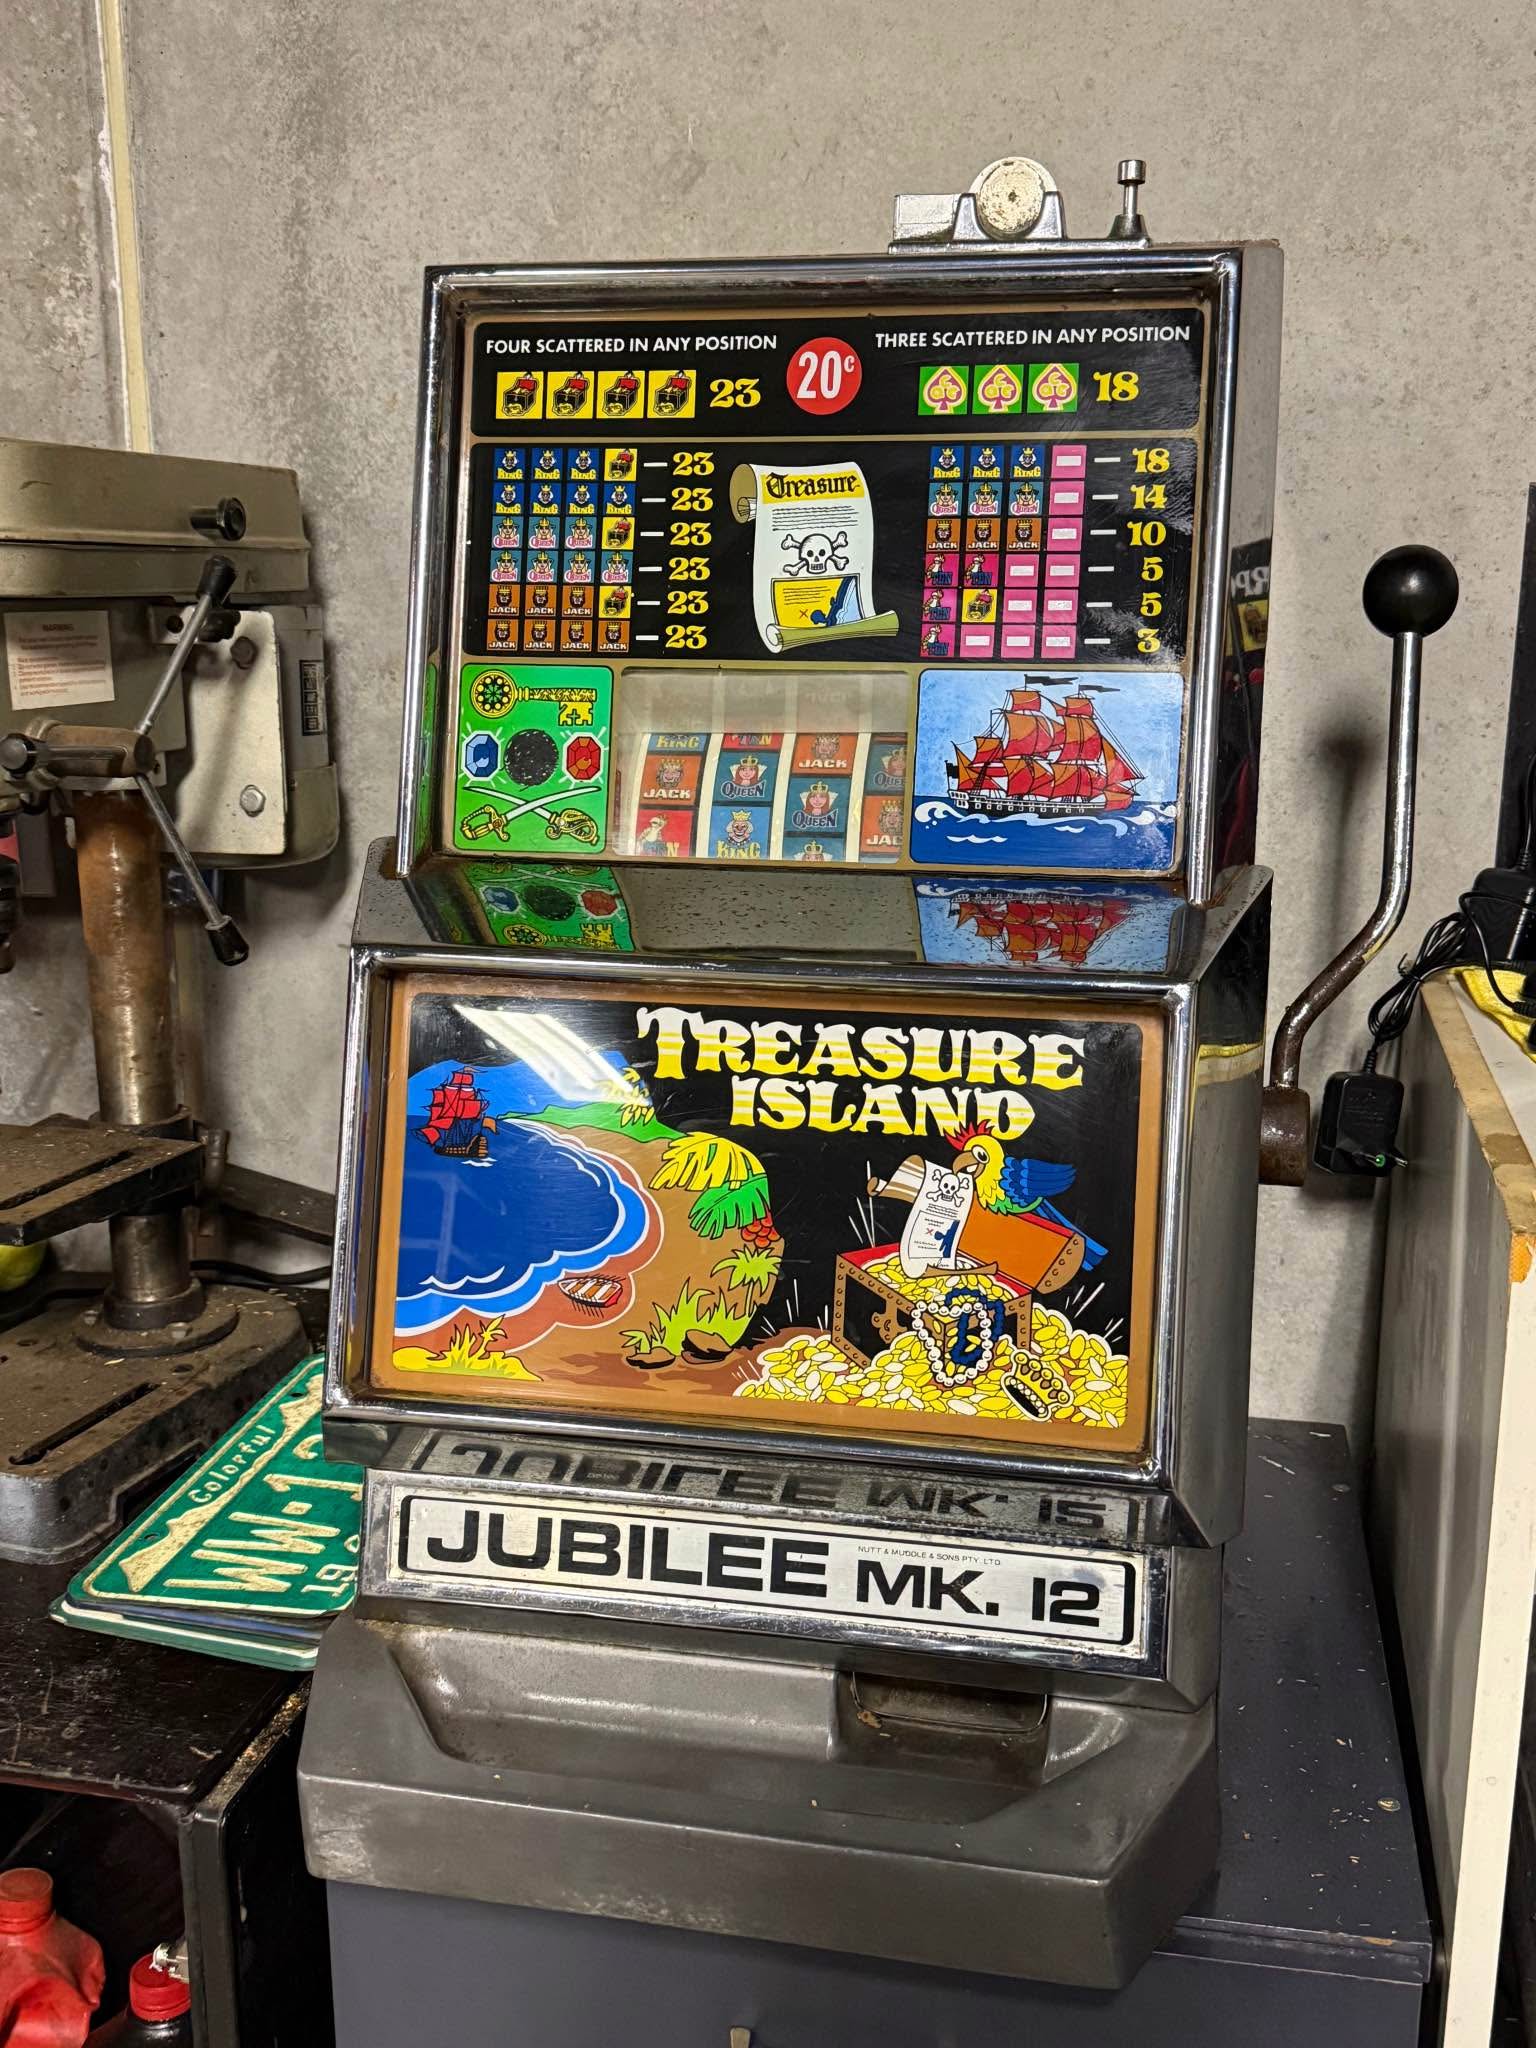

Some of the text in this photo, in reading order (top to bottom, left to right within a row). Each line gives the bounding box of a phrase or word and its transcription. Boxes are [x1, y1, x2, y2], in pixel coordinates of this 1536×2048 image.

[486, 334, 777, 354] FOUR SCATTERED IN ANY POSITION
[875, 325, 1191, 349] THREE SCATTERED IN ANY POSITION
[709, 378, 761, 408] 23
[1093, 371, 1139, 402] 18
[672, 452, 715, 475] 23
[1132, 448, 1170, 473] 18
[765, 472, 860, 498] Treasure
[1130, 484, 1168, 509] 14
[671, 487, 714, 511] 23
[670, 522, 712, 546] 23
[928, 521, 1167, 549] JACK JACK JACK 10
[668, 557, 710, 580] 23
[1141, 556, 1163, 581] 5
[490, 591, 709, 615] JACK JACK JACK 23
[1140, 592, 1162, 616] 5
[489, 625, 707, 650] JACK JACK JACK JACK 23
[1137, 628, 1161, 653] 3
[799, 759, 847, 768] JACK
[643, 780, 766, 799] JACK QUEEN
[792, 808, 839, 829] QUEEN
[717, 840, 760, 858] KING
[866, 834, 903, 845] JAC
[636, 1006, 1085, 1091] TREASURE
[730, 1076, 1036, 1141] ISLAND
[188, 1425, 276, 1503] Colorful
[427, 1510, 1100, 1627] JUBILEE MK. 12
[936, 1553, 960, 1562] SONS
